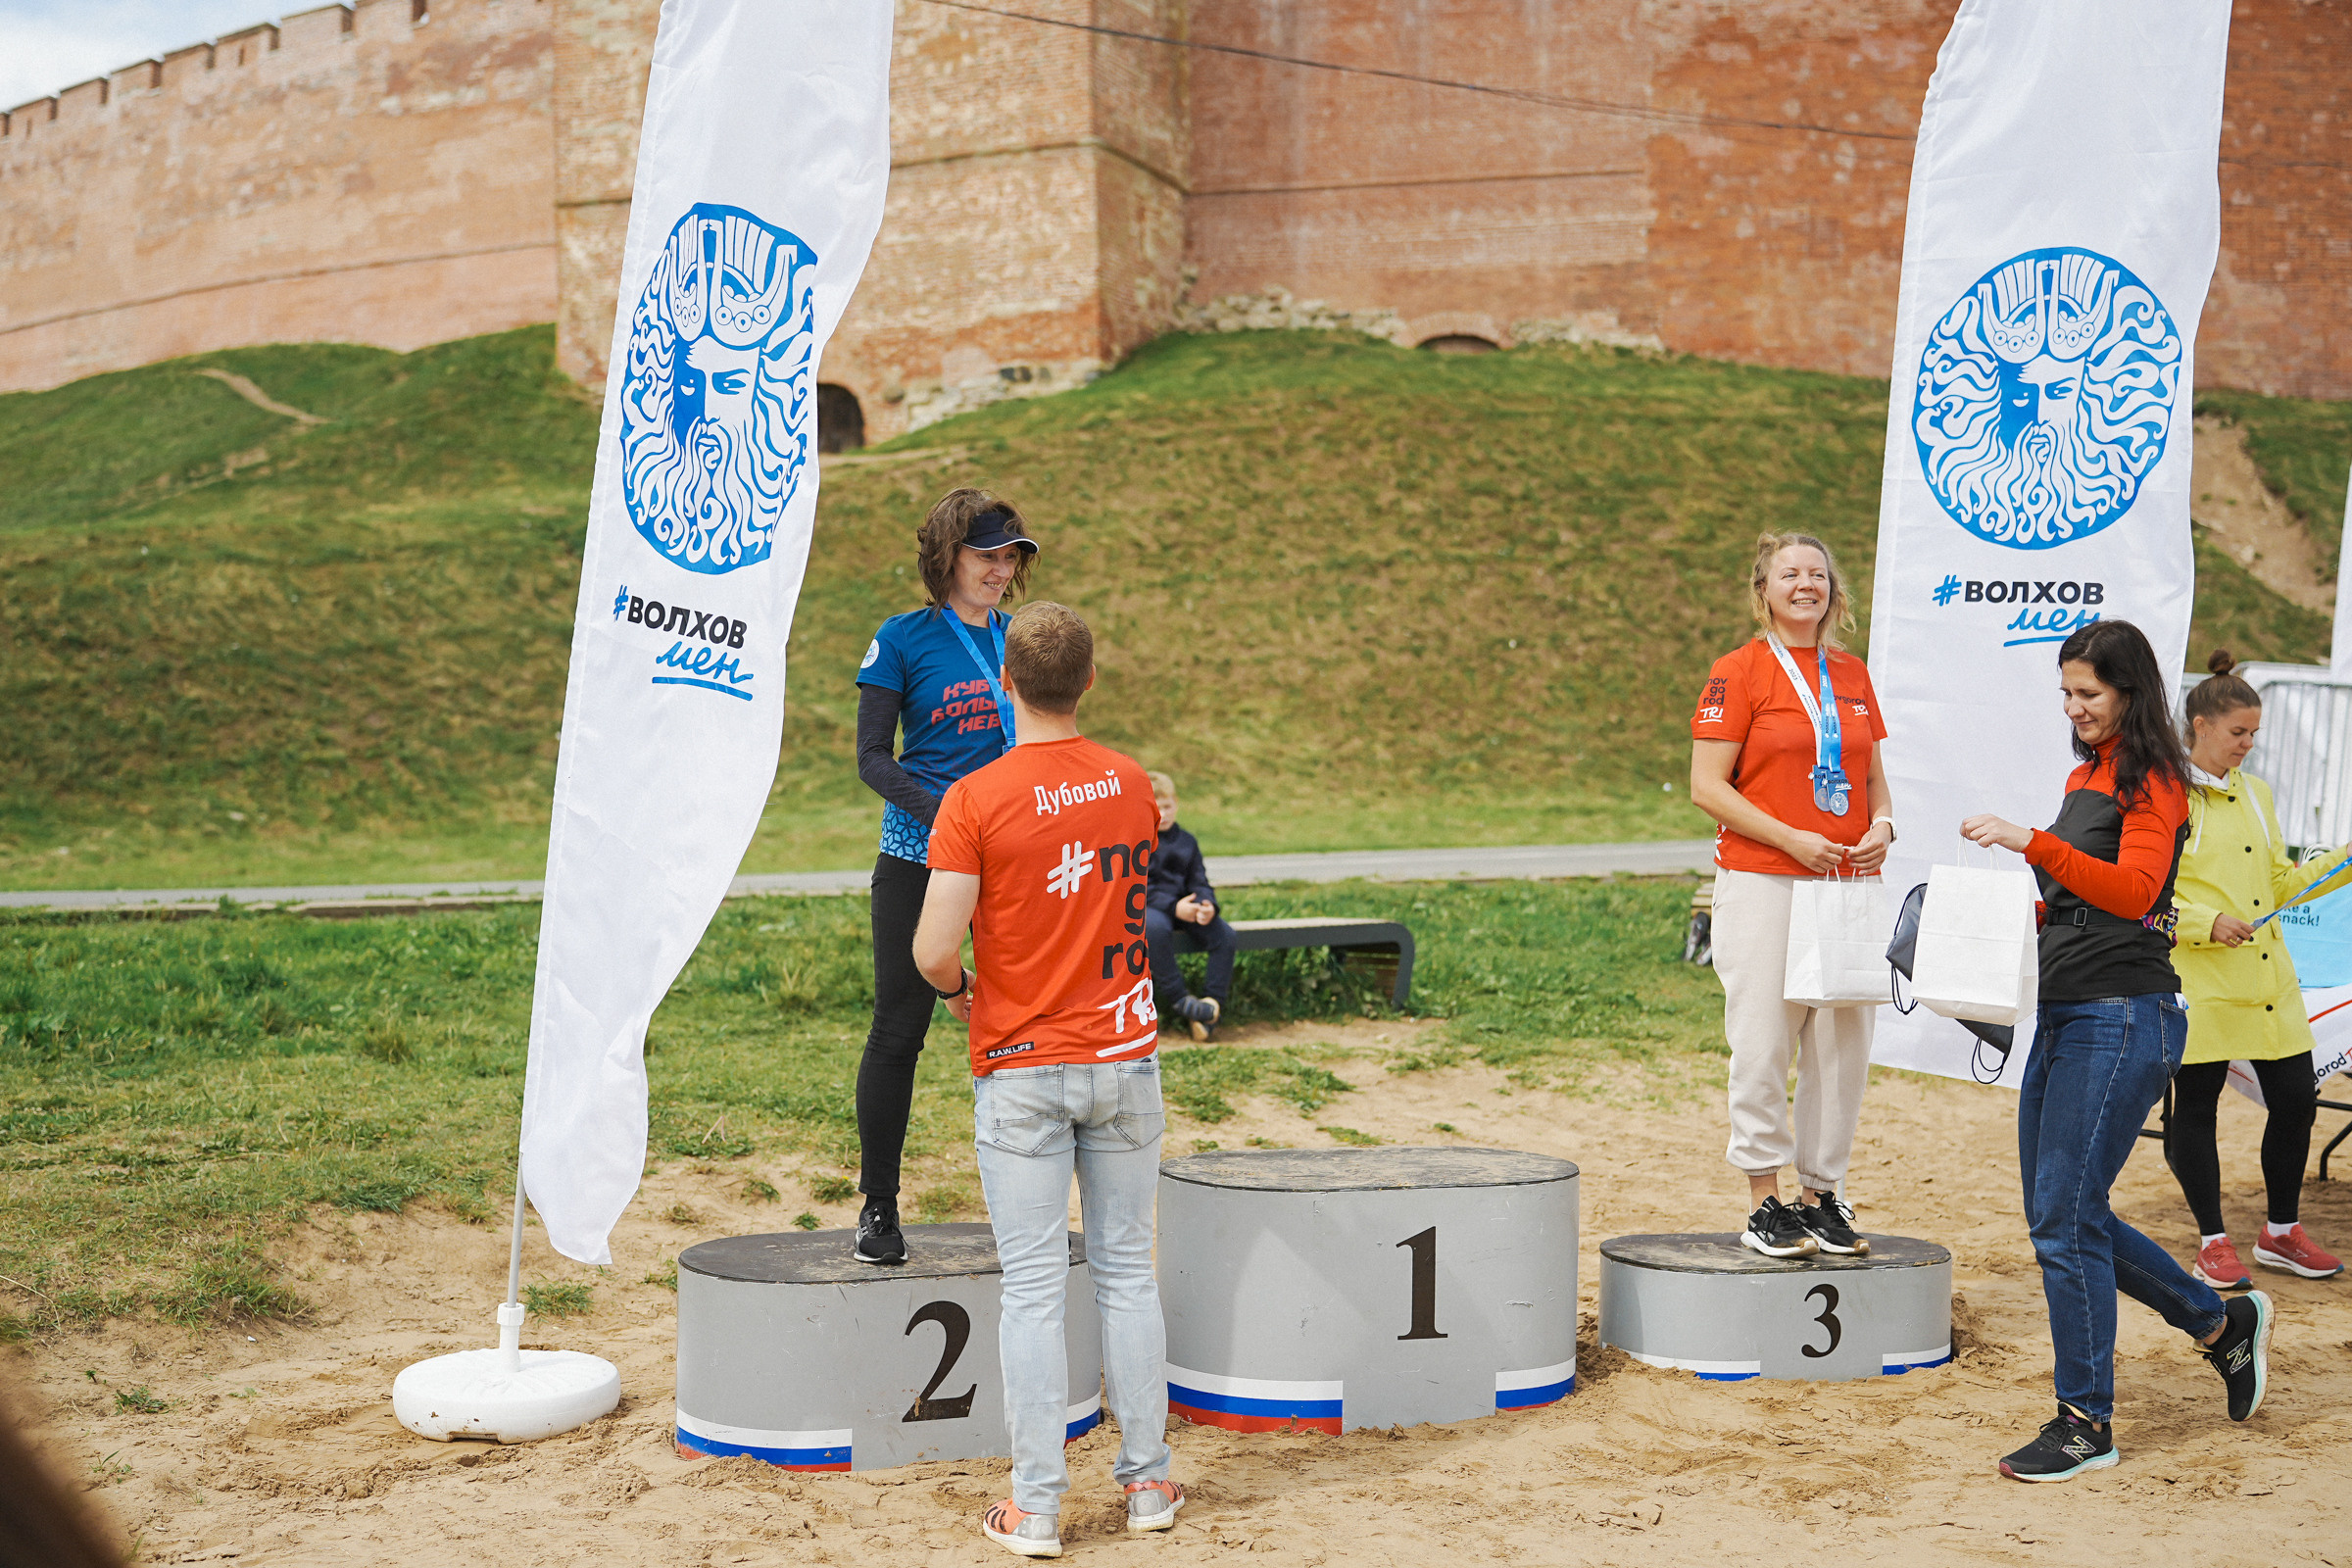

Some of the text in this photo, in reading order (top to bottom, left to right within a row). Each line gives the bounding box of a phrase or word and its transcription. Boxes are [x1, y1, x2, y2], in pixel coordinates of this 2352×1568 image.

[1932, 574, 2105, 607] #ВОЛХОВ
[613, 584, 748, 650] #ВОЛХОВ
[943, 678, 1002, 703] КУБ
[1702, 694, 1725, 705] rod
[1709, 686, 1726, 698] go
[1034, 769, 1122, 815] Дубовой
[989, 1043, 1032, 1058] R.A.W.LIFE
[1396, 1225, 1449, 1341] 1
[1800, 1283, 1842, 1358] 3
[901, 1299, 978, 1423] 2
